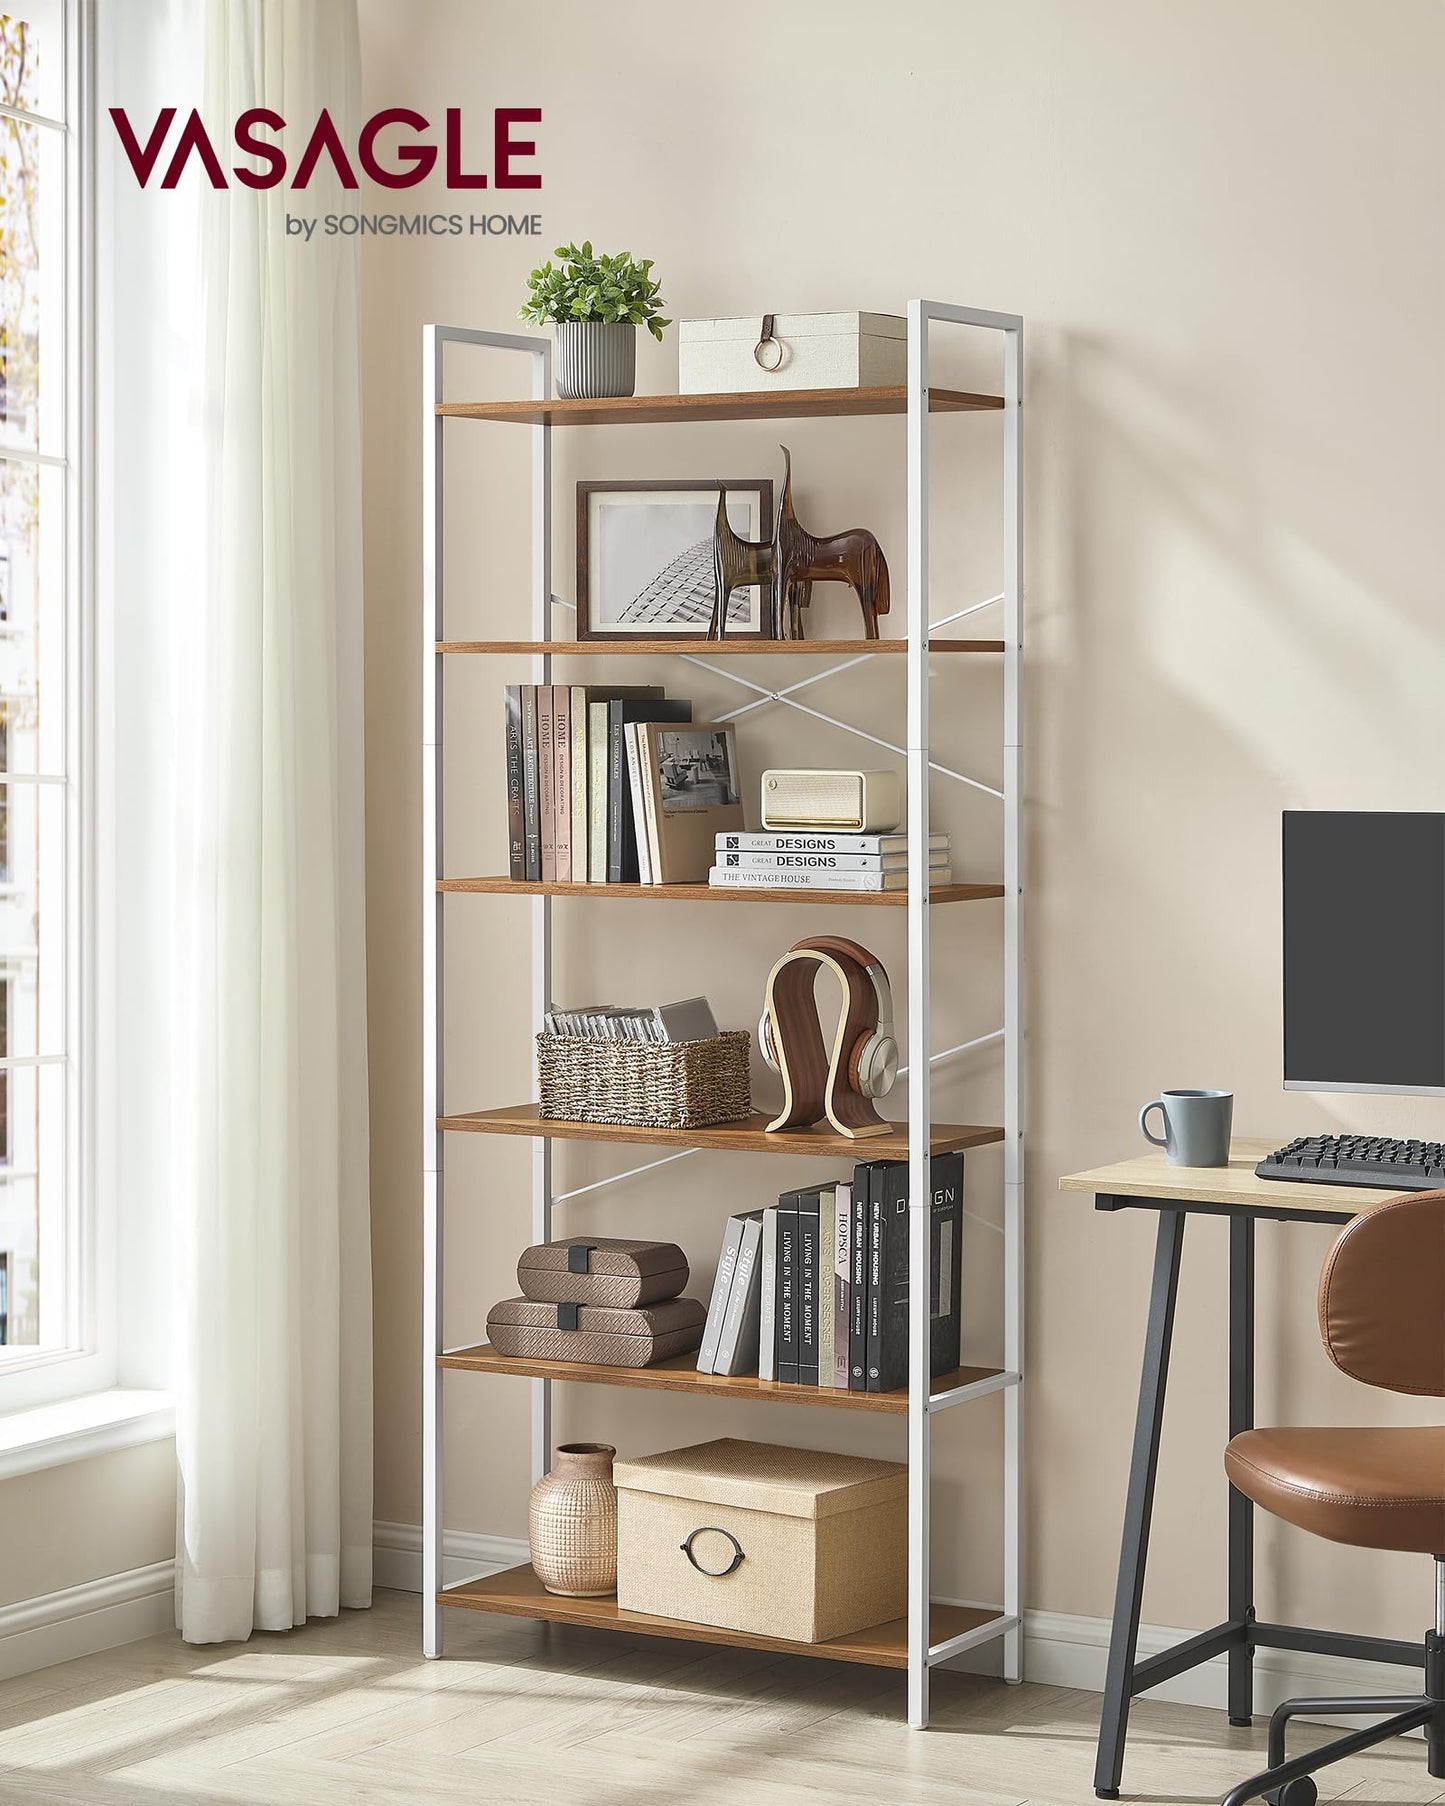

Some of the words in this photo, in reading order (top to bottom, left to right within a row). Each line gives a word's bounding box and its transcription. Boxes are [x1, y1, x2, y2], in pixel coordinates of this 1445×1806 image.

[509, 725, 518, 750] ARTS
[541, 713, 550, 749] HOME
[557, 713, 566, 749] HOME
[510, 754, 518, 774] THE
[511, 778, 520, 816] CRAFTS
[776, 838, 836, 850] DESIGNS
[722, 873, 740, 881] THE
[776, 856, 836, 867] DESIGNS
[783, 1231, 792, 1262] LIVING
[804, 1233, 812, 1264] LIVING
[838, 1213, 848, 1264] HOPSCA
[720, 1246, 737, 1284] Style
[737, 1248, 754, 1286] Style
[784, 1266, 791, 1276] IN
[804, 1268, 812, 1278] IN
[804, 1304, 812, 1345] MOMENT
